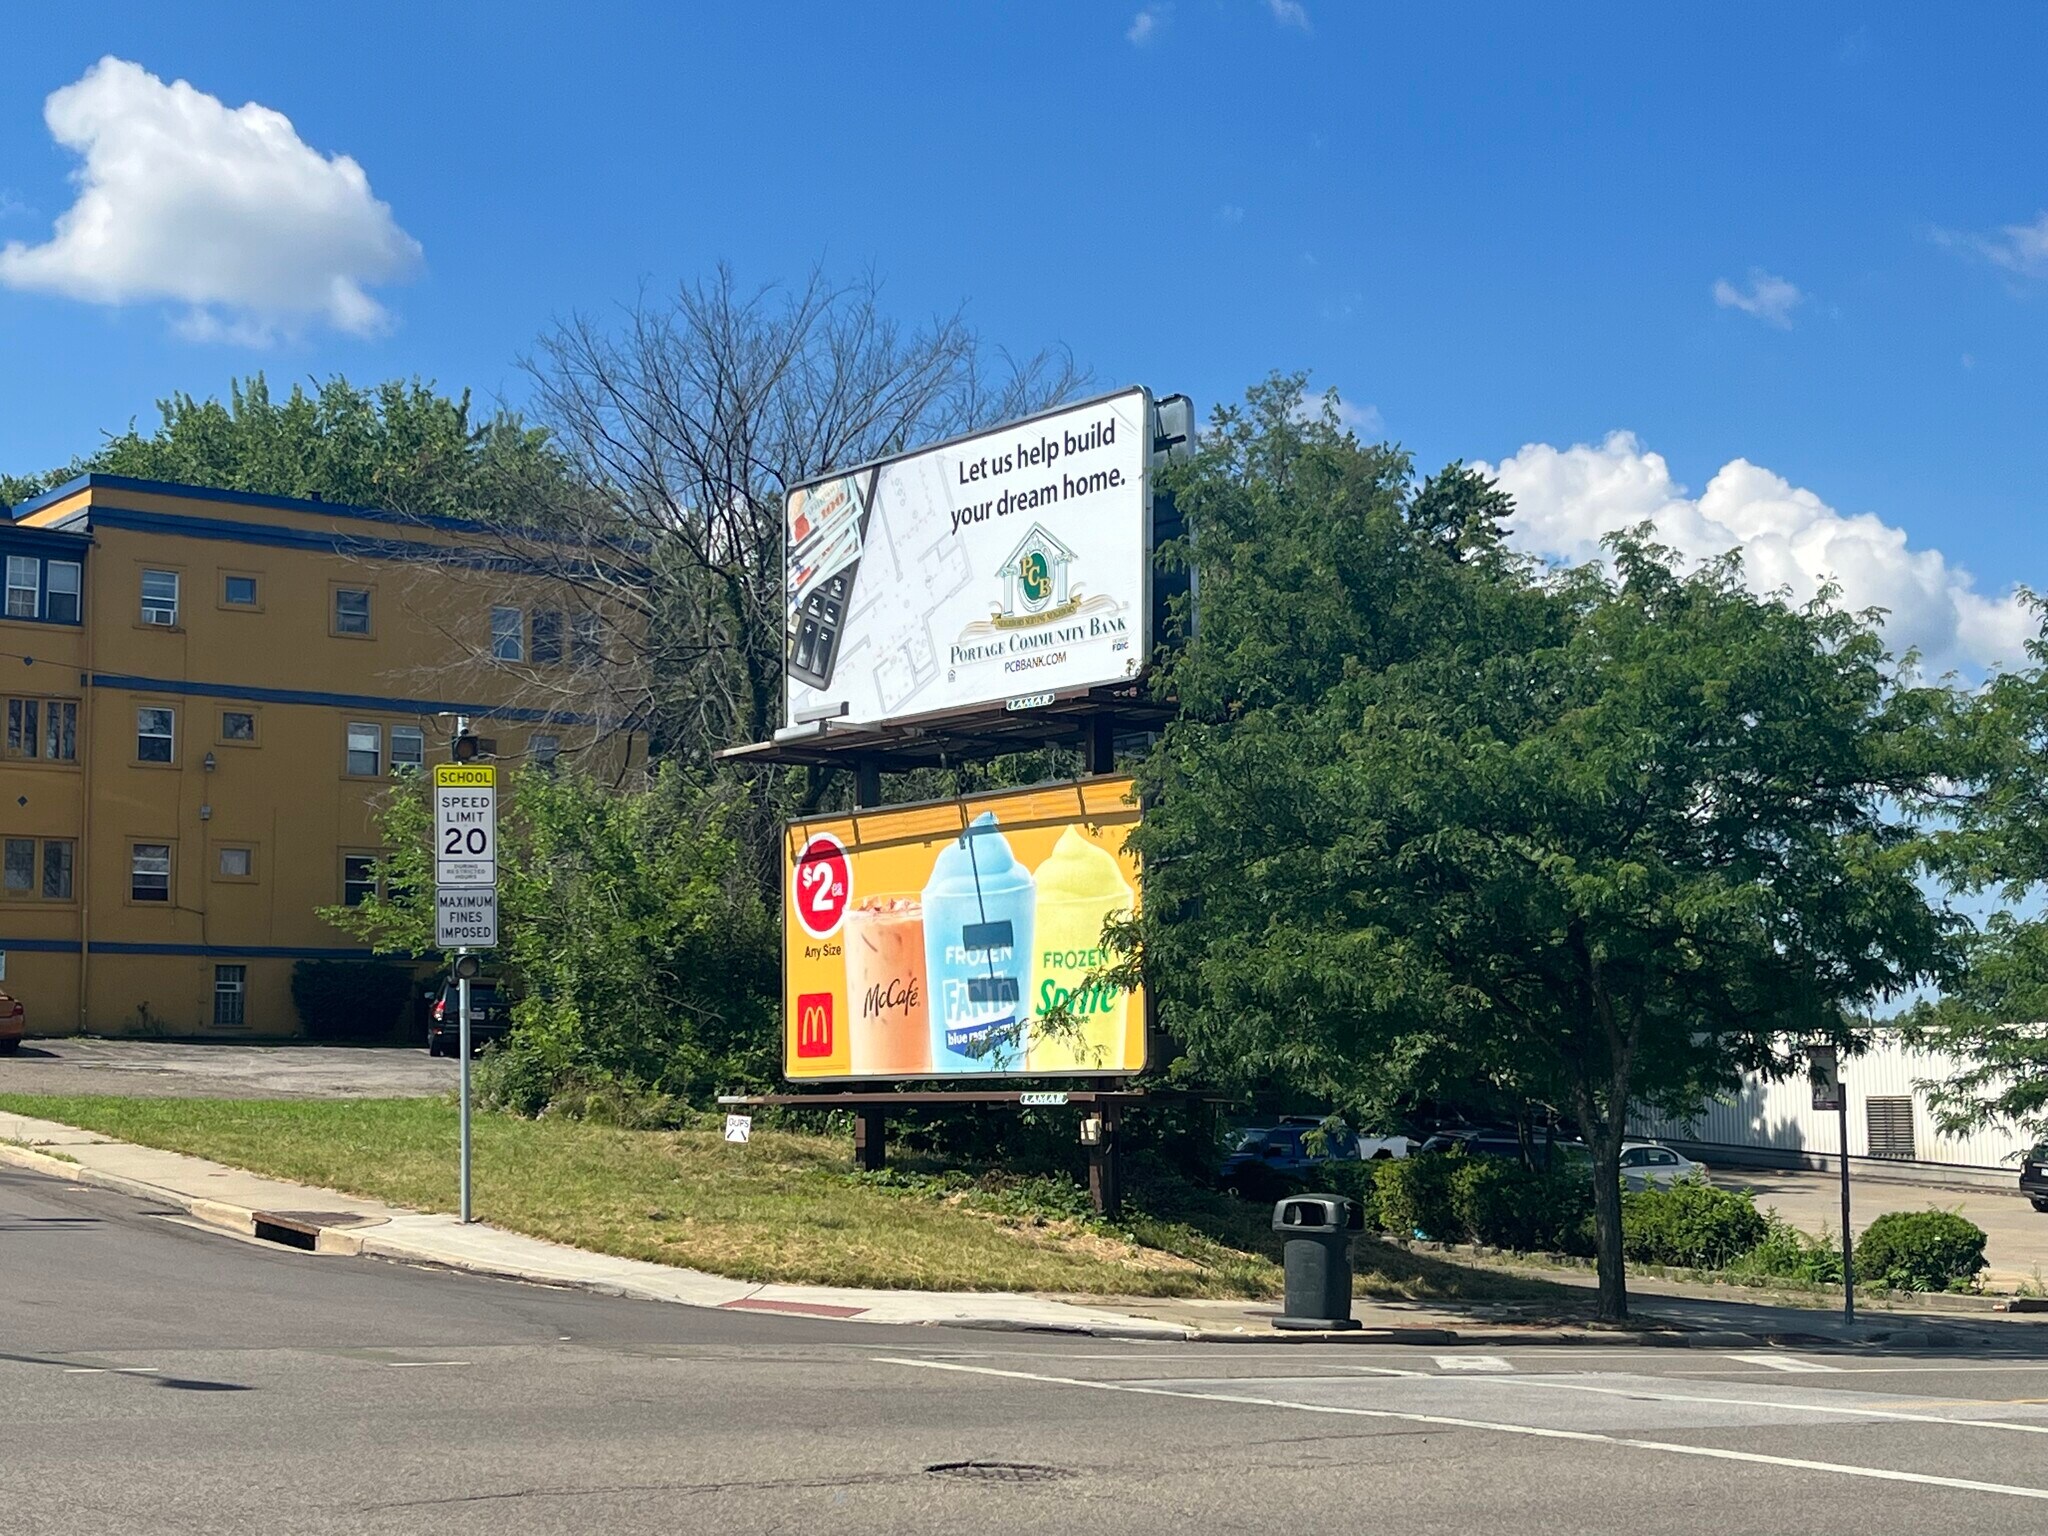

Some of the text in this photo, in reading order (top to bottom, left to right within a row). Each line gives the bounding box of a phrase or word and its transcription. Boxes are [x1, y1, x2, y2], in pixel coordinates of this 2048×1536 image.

[959, 418, 1115, 485] Let us help build
[951, 468, 1126, 535] your dream home.
[951, 617, 1127, 665] PORTAGE COMMUNITY BANK
[1004, 651, 1067, 674] PCBBANK.COM
[440, 772, 491, 783] SCHOOL
[441, 797, 490, 808] SPEED
[446, 812, 485, 823] LIMIT
[444, 828, 487, 855] 20
[439, 896, 493, 908] MAXIMUM
[449, 912, 483, 923] FINES
[441, 927, 491, 939] IMPOSED
[804, 942, 842, 961] Any Size
[945, 944, 1012, 966] FROZEN
[1043, 949, 1109, 969] FROZEN
[863, 977, 919, 1018] McCafé
[947, 1031, 968, 1046] blue
